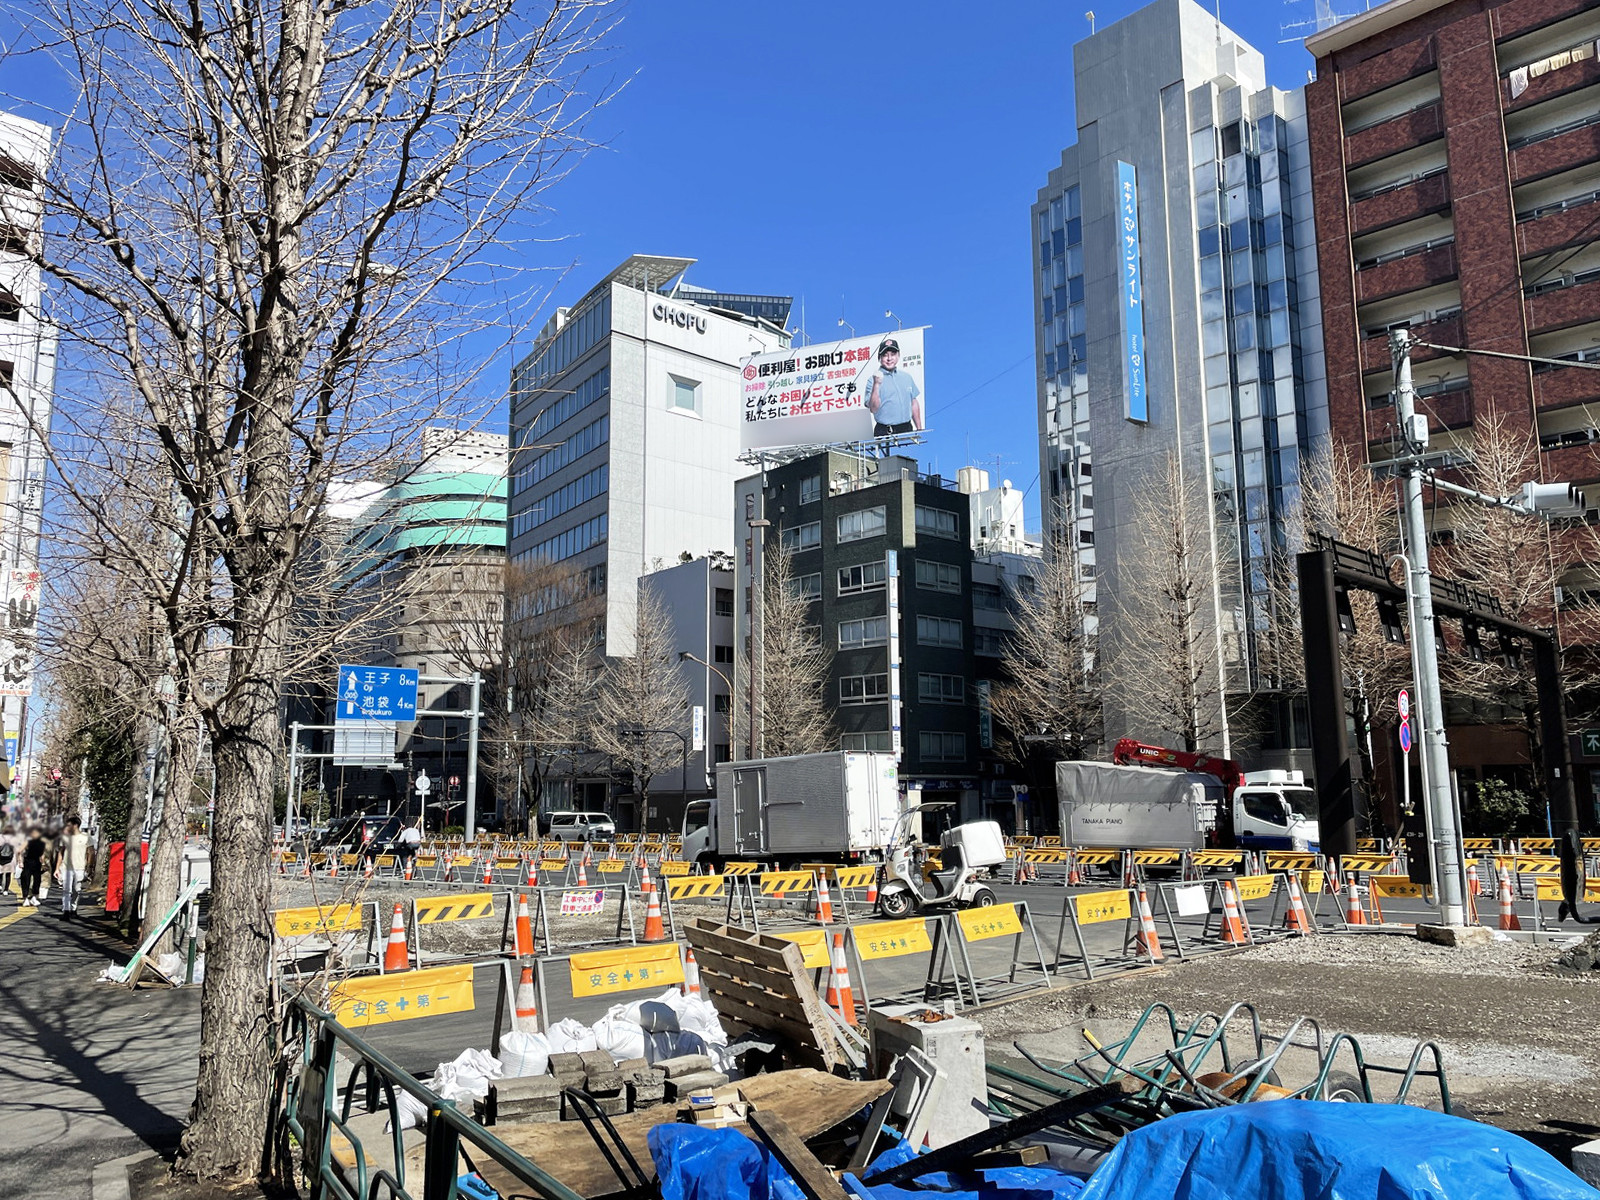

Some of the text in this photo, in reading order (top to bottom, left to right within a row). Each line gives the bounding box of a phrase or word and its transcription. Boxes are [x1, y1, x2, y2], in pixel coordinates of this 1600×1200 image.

[1124, 181, 1139, 308] ホテル サンライト
[652, 302, 708, 335] CHOFU
[805, 346, 870, 369] お助け本舗
[364, 671, 391, 684] 王子
[363, 684, 373, 692] Oji
[362, 696, 389, 708] 池袋
[1140, 748, 1159, 756] UNIC
